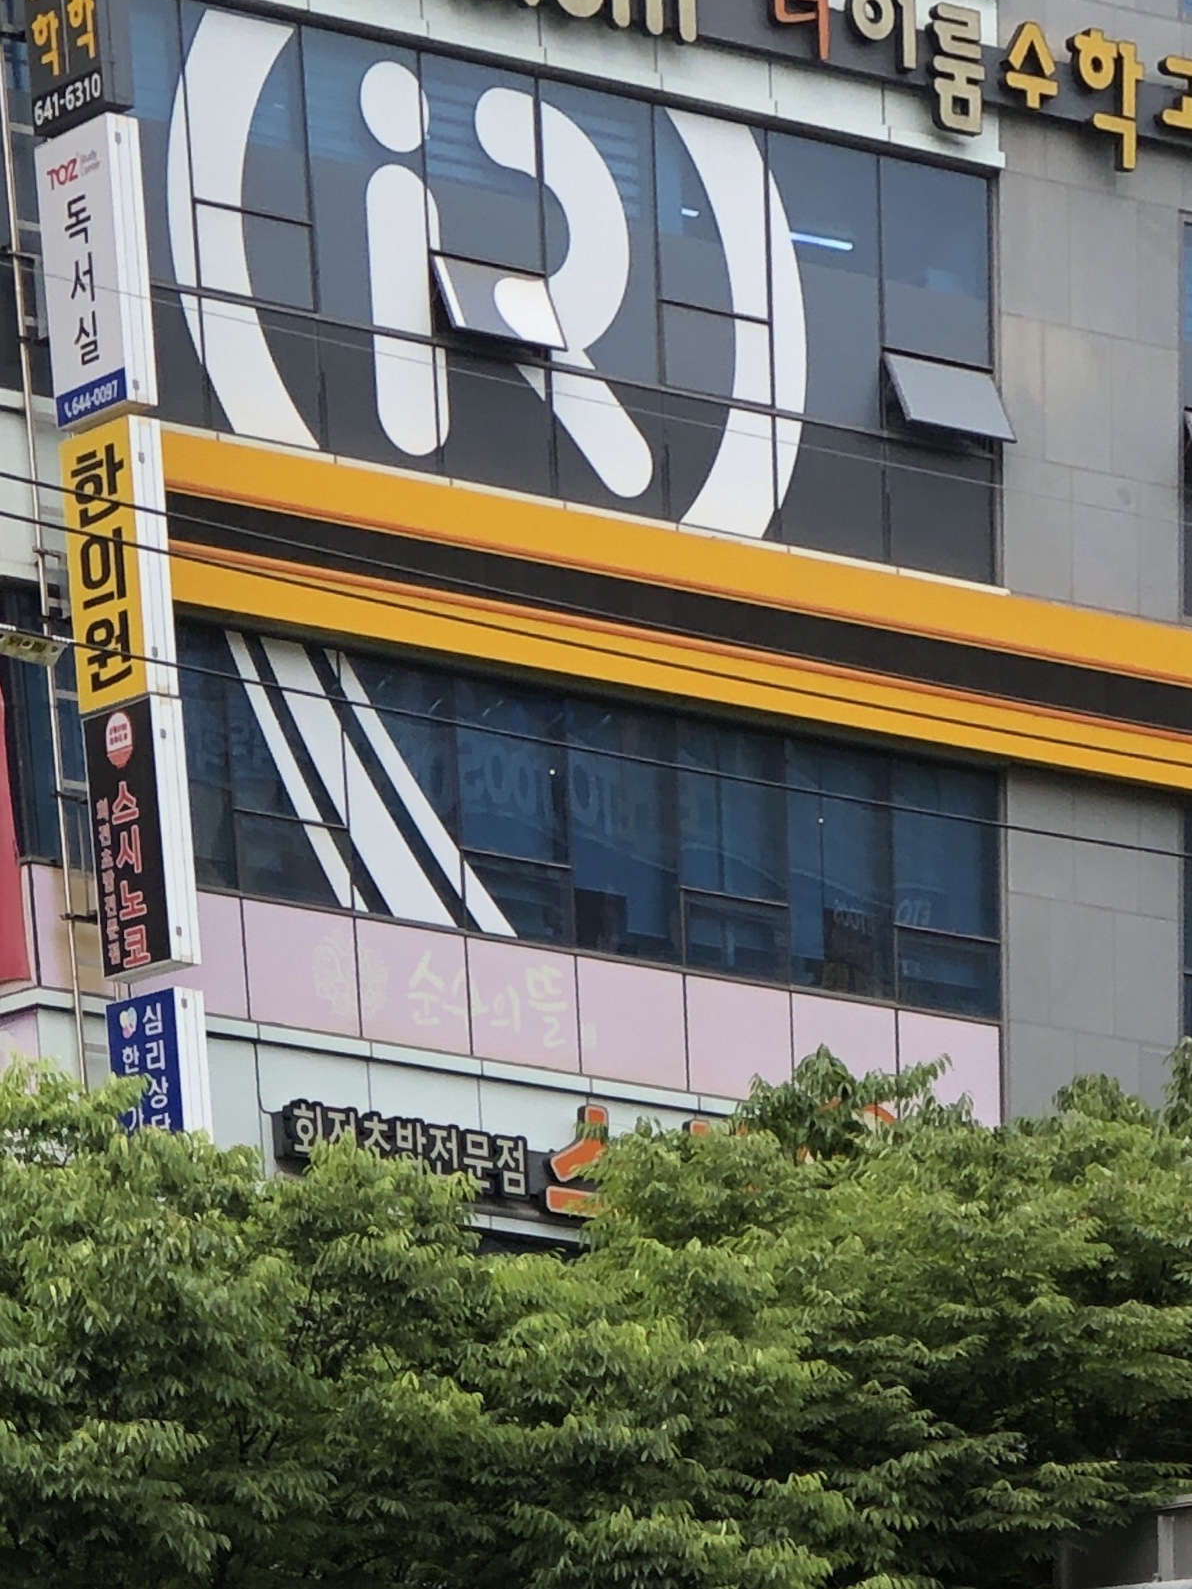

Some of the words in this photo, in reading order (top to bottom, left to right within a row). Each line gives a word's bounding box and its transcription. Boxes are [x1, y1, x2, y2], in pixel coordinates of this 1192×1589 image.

[33, 72, 101, 127] 641-6310
[64, 193, 100, 367] 독서실
[70, 442, 134, 693] 한의원
[110, 779, 152, 969] 스시노코
